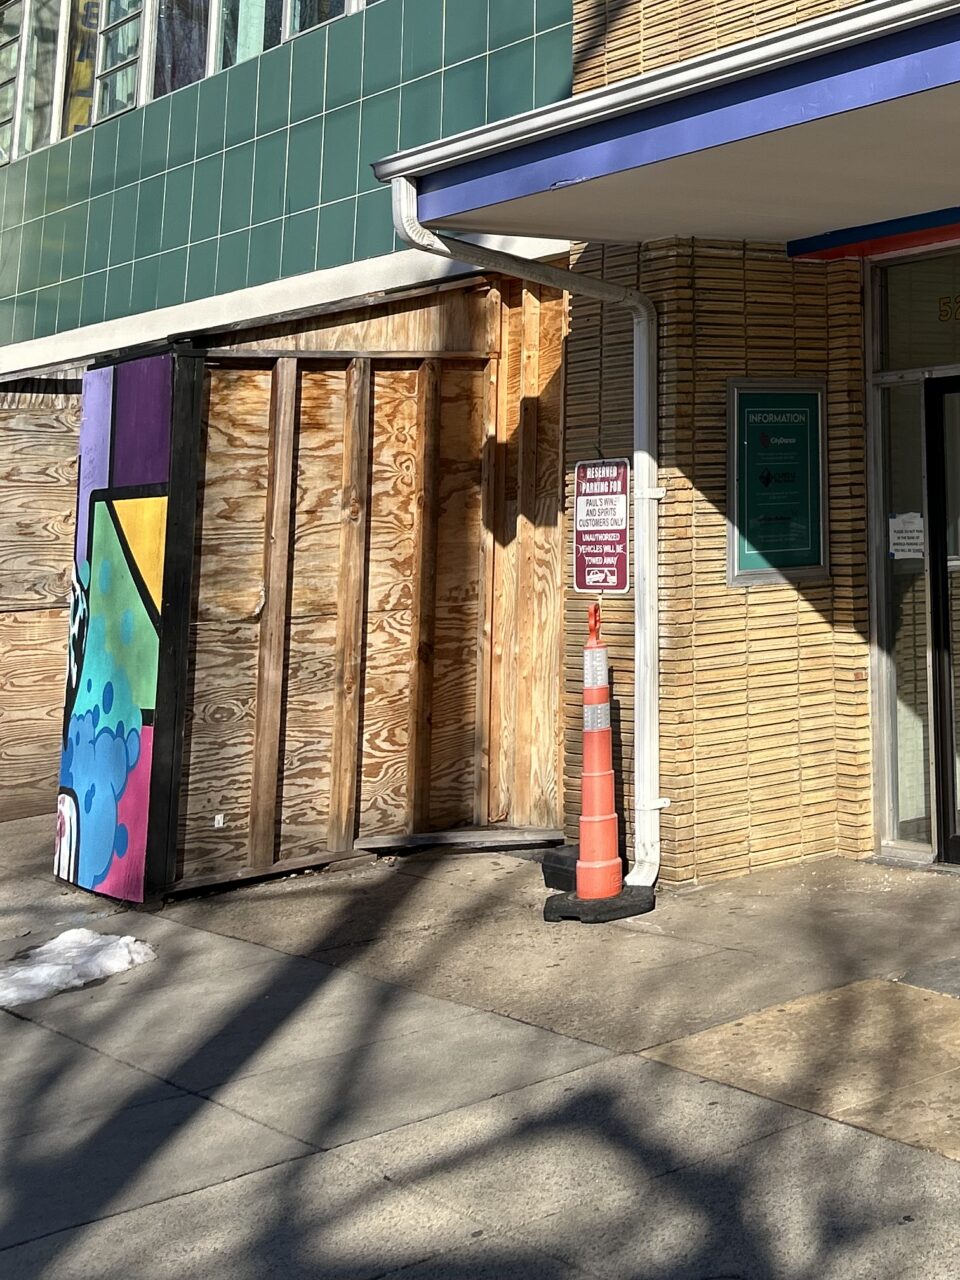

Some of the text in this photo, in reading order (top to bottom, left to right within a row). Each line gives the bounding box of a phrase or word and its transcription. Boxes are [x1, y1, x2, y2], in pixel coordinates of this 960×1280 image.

[750, 413, 806, 423] INFORMATION
[586, 466, 617, 478] RESERVED
[582, 480, 622, 493] PARKING FOR
[586, 498, 603, 507] PAUL'S
[586, 507, 616, 517] AND SPIRITS
[579, 518, 623, 527] CUSTOMERS ONLY
[582, 533, 620, 542] UNAUTHORIZED
[579, 545, 624, 554] VEHICLES WILL BE
[585, 556, 618, 566] TOWED AWAY
